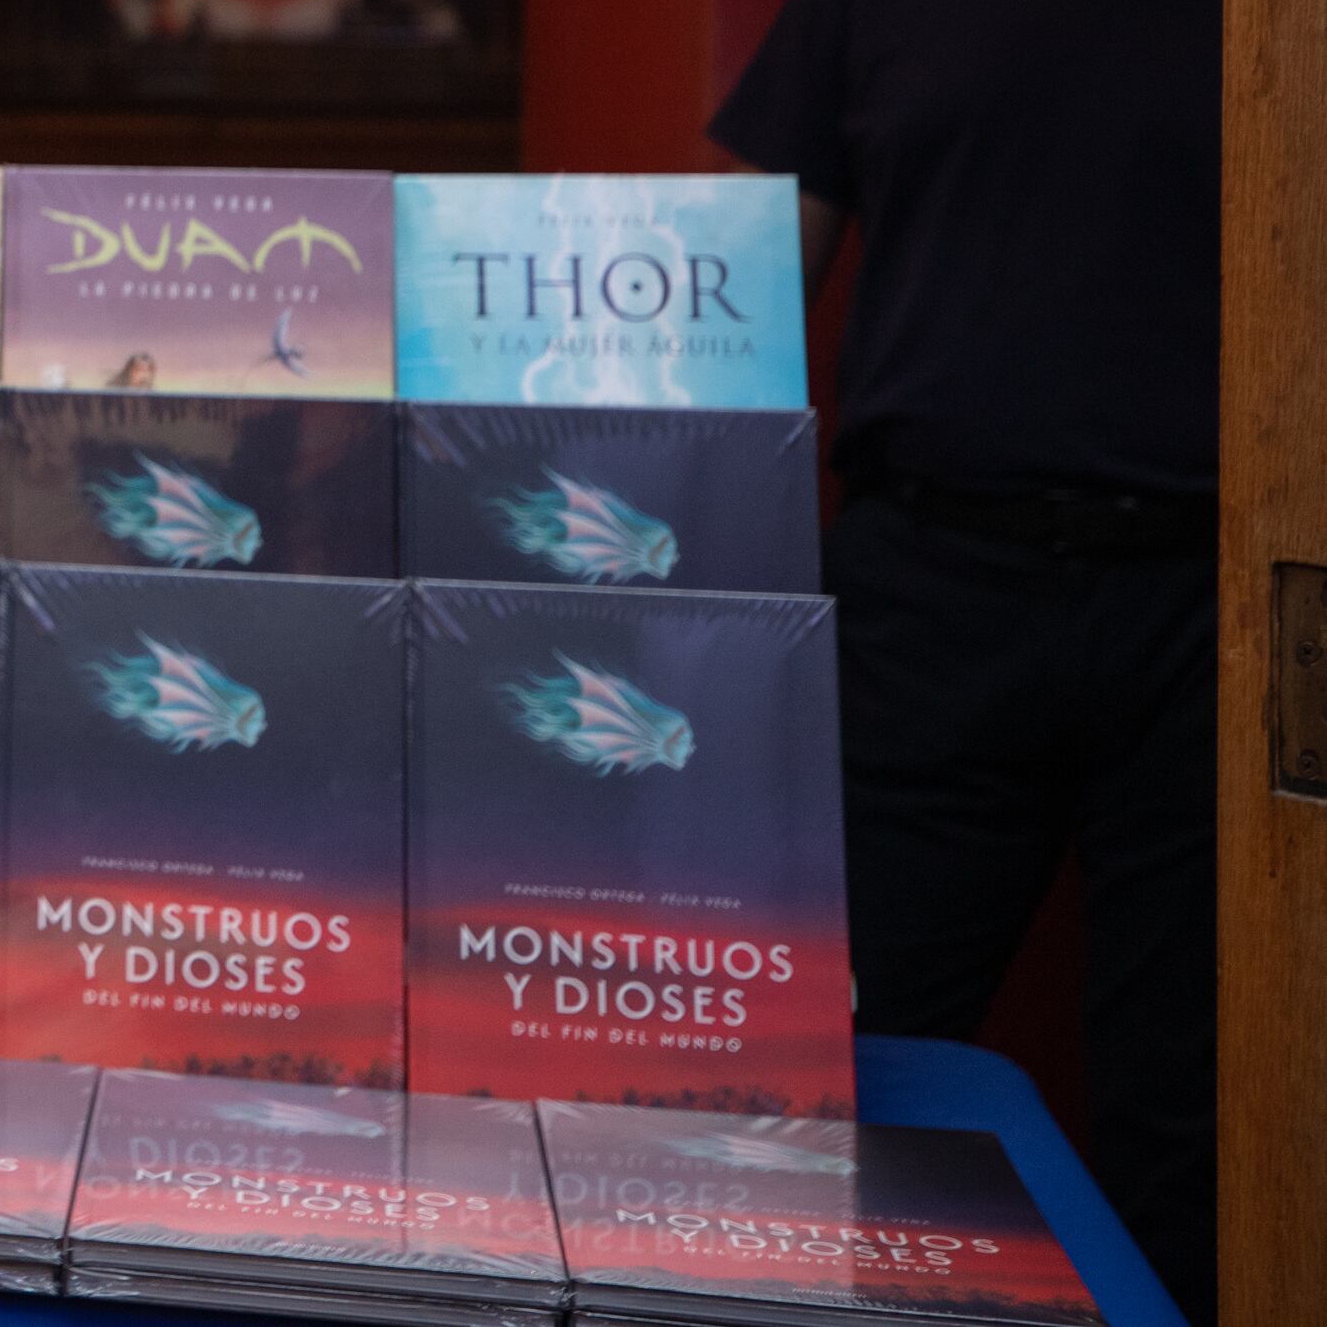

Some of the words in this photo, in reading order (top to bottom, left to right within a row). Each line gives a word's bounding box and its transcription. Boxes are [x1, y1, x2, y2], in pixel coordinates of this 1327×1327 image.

[449, 251, 752, 324] THOR
[36, 895, 352, 954] MONSTRUOS
[78, 942, 105, 980] Y
[125, 946, 307, 996] DIOSES
[458, 923, 794, 983] MONSTRUOS
[82, 988, 121, 1007] DEL
[130, 992, 166, 1009] FIN
[173, 996, 213, 1014] DEL
[221, 1001, 300, 1021] MUNDO
[503, 972, 532, 1011] Y
[554, 975, 748, 1027] DIOSES
[511, 1020, 551, 1039] DEL
[560, 1024, 599, 1042] FIN
[608, 1029, 649, 1047] DEL
[659, 1034, 743, 1054] MUNDO
[135, 1168, 491, 1211] MONSTRUOS
[182, 1185, 209, 1200] Y
[234, 1190, 441, 1222] DIOSES
[615, 1208, 1001, 1255] MONSTRUOS
[670, 1227, 700, 1244] Y
[729, 1233, 953, 1266] DIOSES
[683, 1245, 726, 1257] DEL
[741, 1251, 782, 1261] FIN
[797, 1255, 841, 1266] DEL
[856, 1261, 952, 1275] MUNDO
